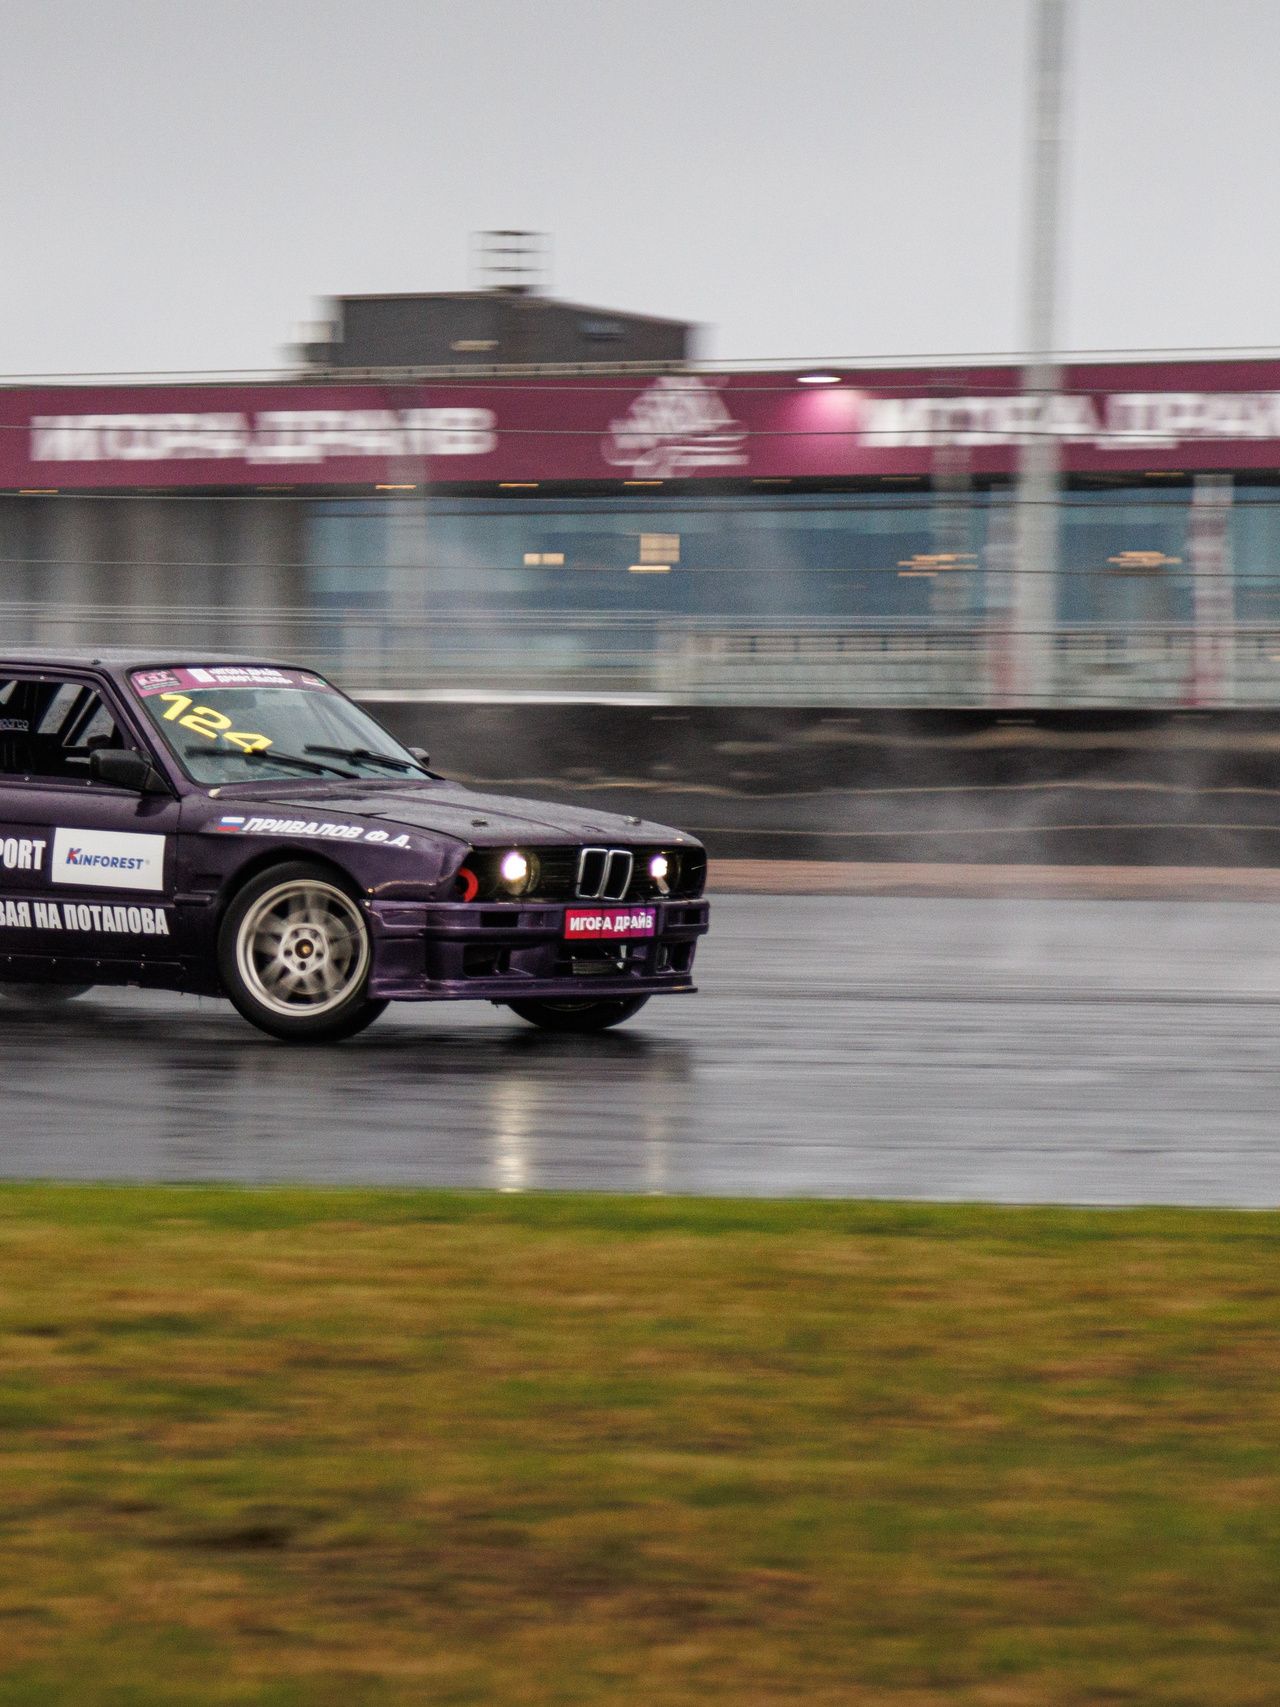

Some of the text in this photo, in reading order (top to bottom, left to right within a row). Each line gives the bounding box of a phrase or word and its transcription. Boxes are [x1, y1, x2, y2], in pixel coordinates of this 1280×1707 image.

[160, 694, 273, 754] 124
[242, 817, 412, 849] ПРИВАЛОВ Ф.А.
[66, 847, 144, 870] KINFOREST
[33, 902, 63, 930] НА
[63, 903, 170, 935] ПОТАПОВА
[570, 911, 653, 932] ИГОРА ДРАЙВ
